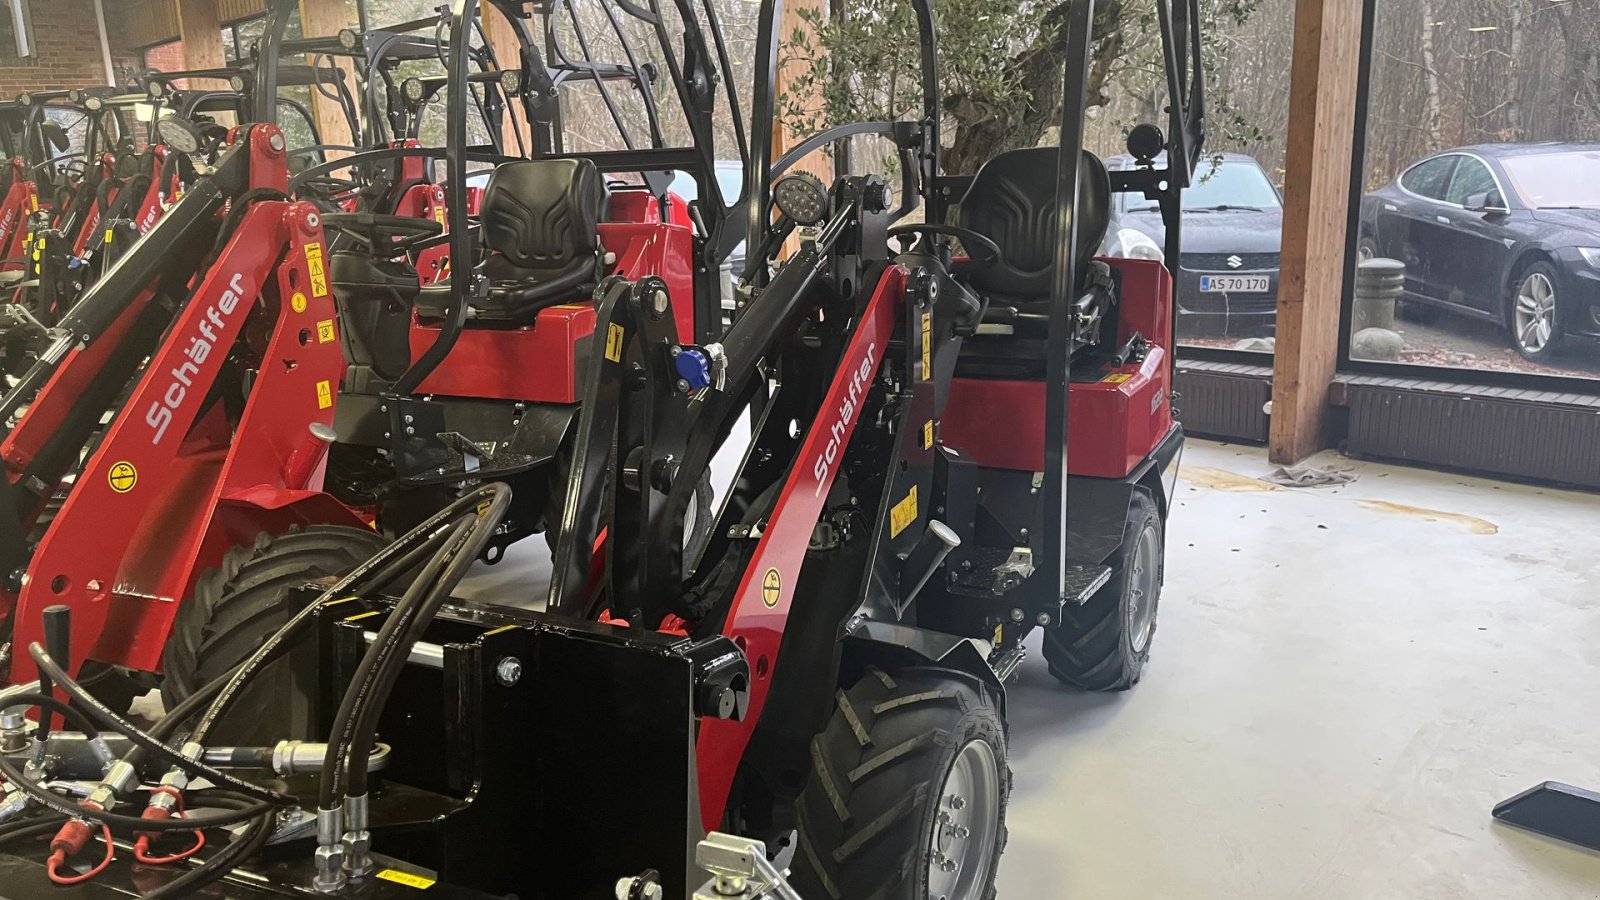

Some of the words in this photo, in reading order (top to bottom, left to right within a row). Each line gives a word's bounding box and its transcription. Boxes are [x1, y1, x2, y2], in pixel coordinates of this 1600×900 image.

[145, 272, 245, 445] Schäffer
[1210, 279, 1225, 290] AS
[1228, 279, 1242, 290] 70
[1246, 279, 1267, 290] 170
[814, 342, 876, 498] Schäffer
